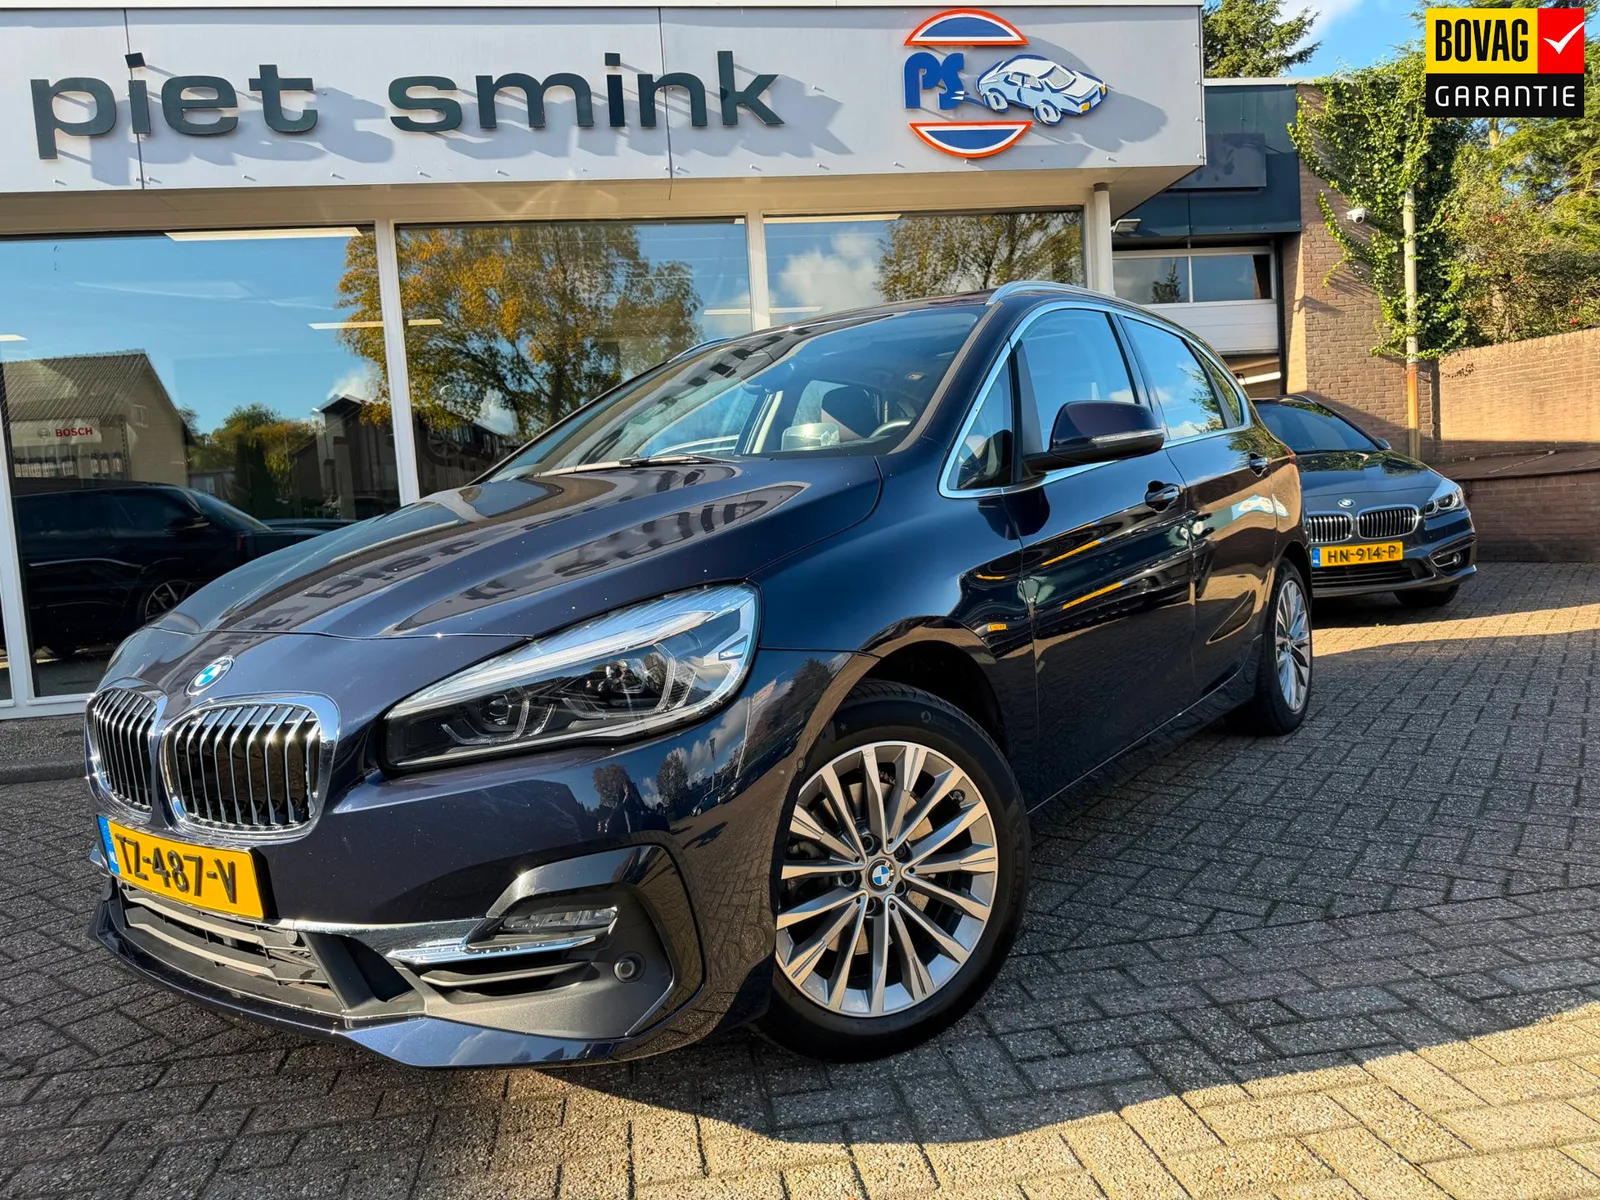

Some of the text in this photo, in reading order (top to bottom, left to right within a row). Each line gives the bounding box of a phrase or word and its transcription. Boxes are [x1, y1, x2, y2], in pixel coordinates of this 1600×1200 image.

[30, 51, 785, 160] piet smink
[55, 427, 93, 437] BOSCH
[1327, 545, 1397, 563] HN-914-P
[115, 833, 237, 905] TZ-487-V
